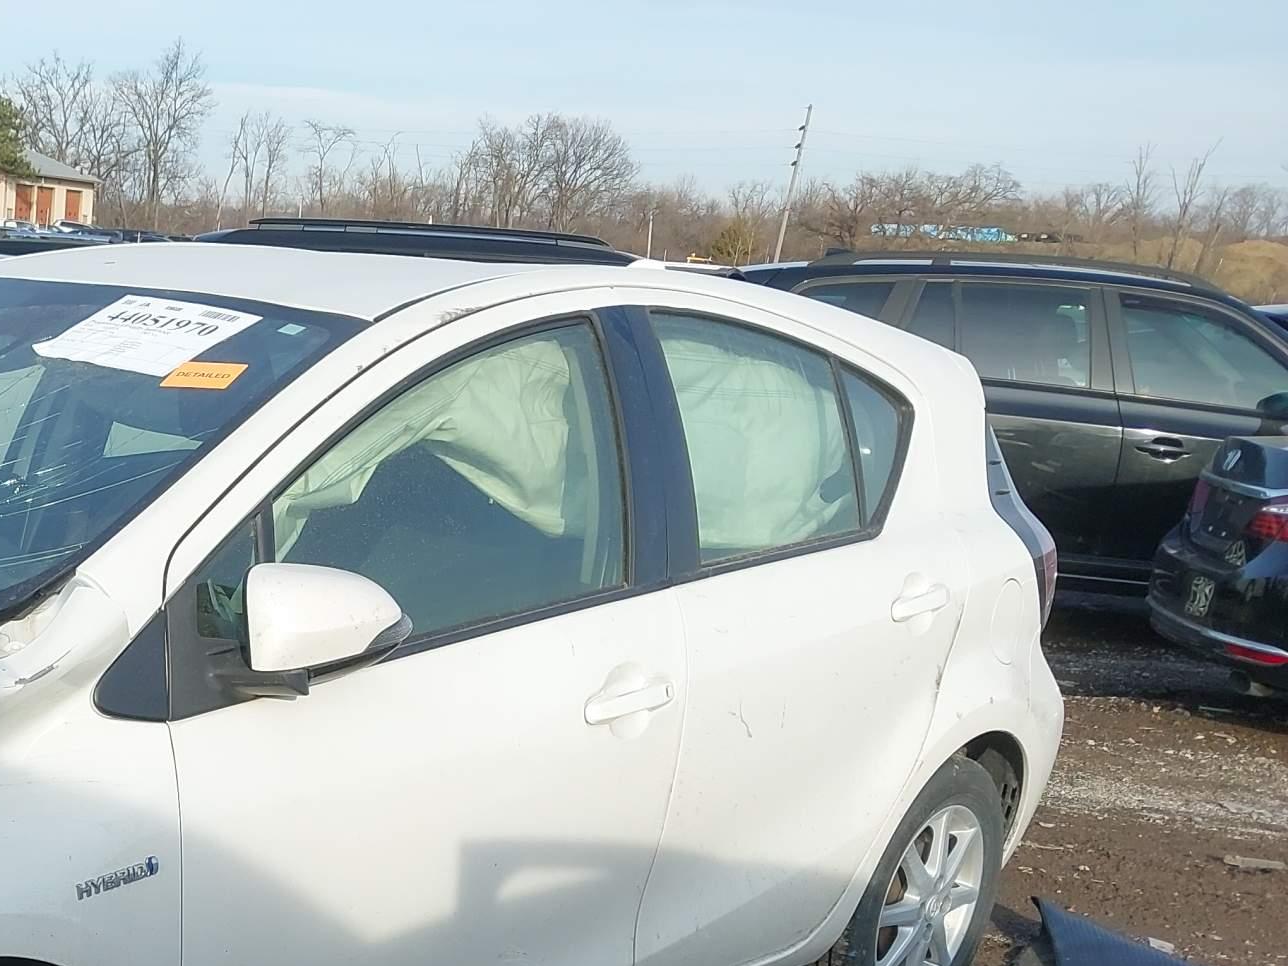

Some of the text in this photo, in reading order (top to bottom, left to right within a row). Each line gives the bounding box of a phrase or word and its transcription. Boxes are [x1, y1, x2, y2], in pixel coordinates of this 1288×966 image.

[107, 310, 220, 336] 44051970
[175, 370, 232, 380] DETAILED
[75, 863, 146, 901] HYBRID
